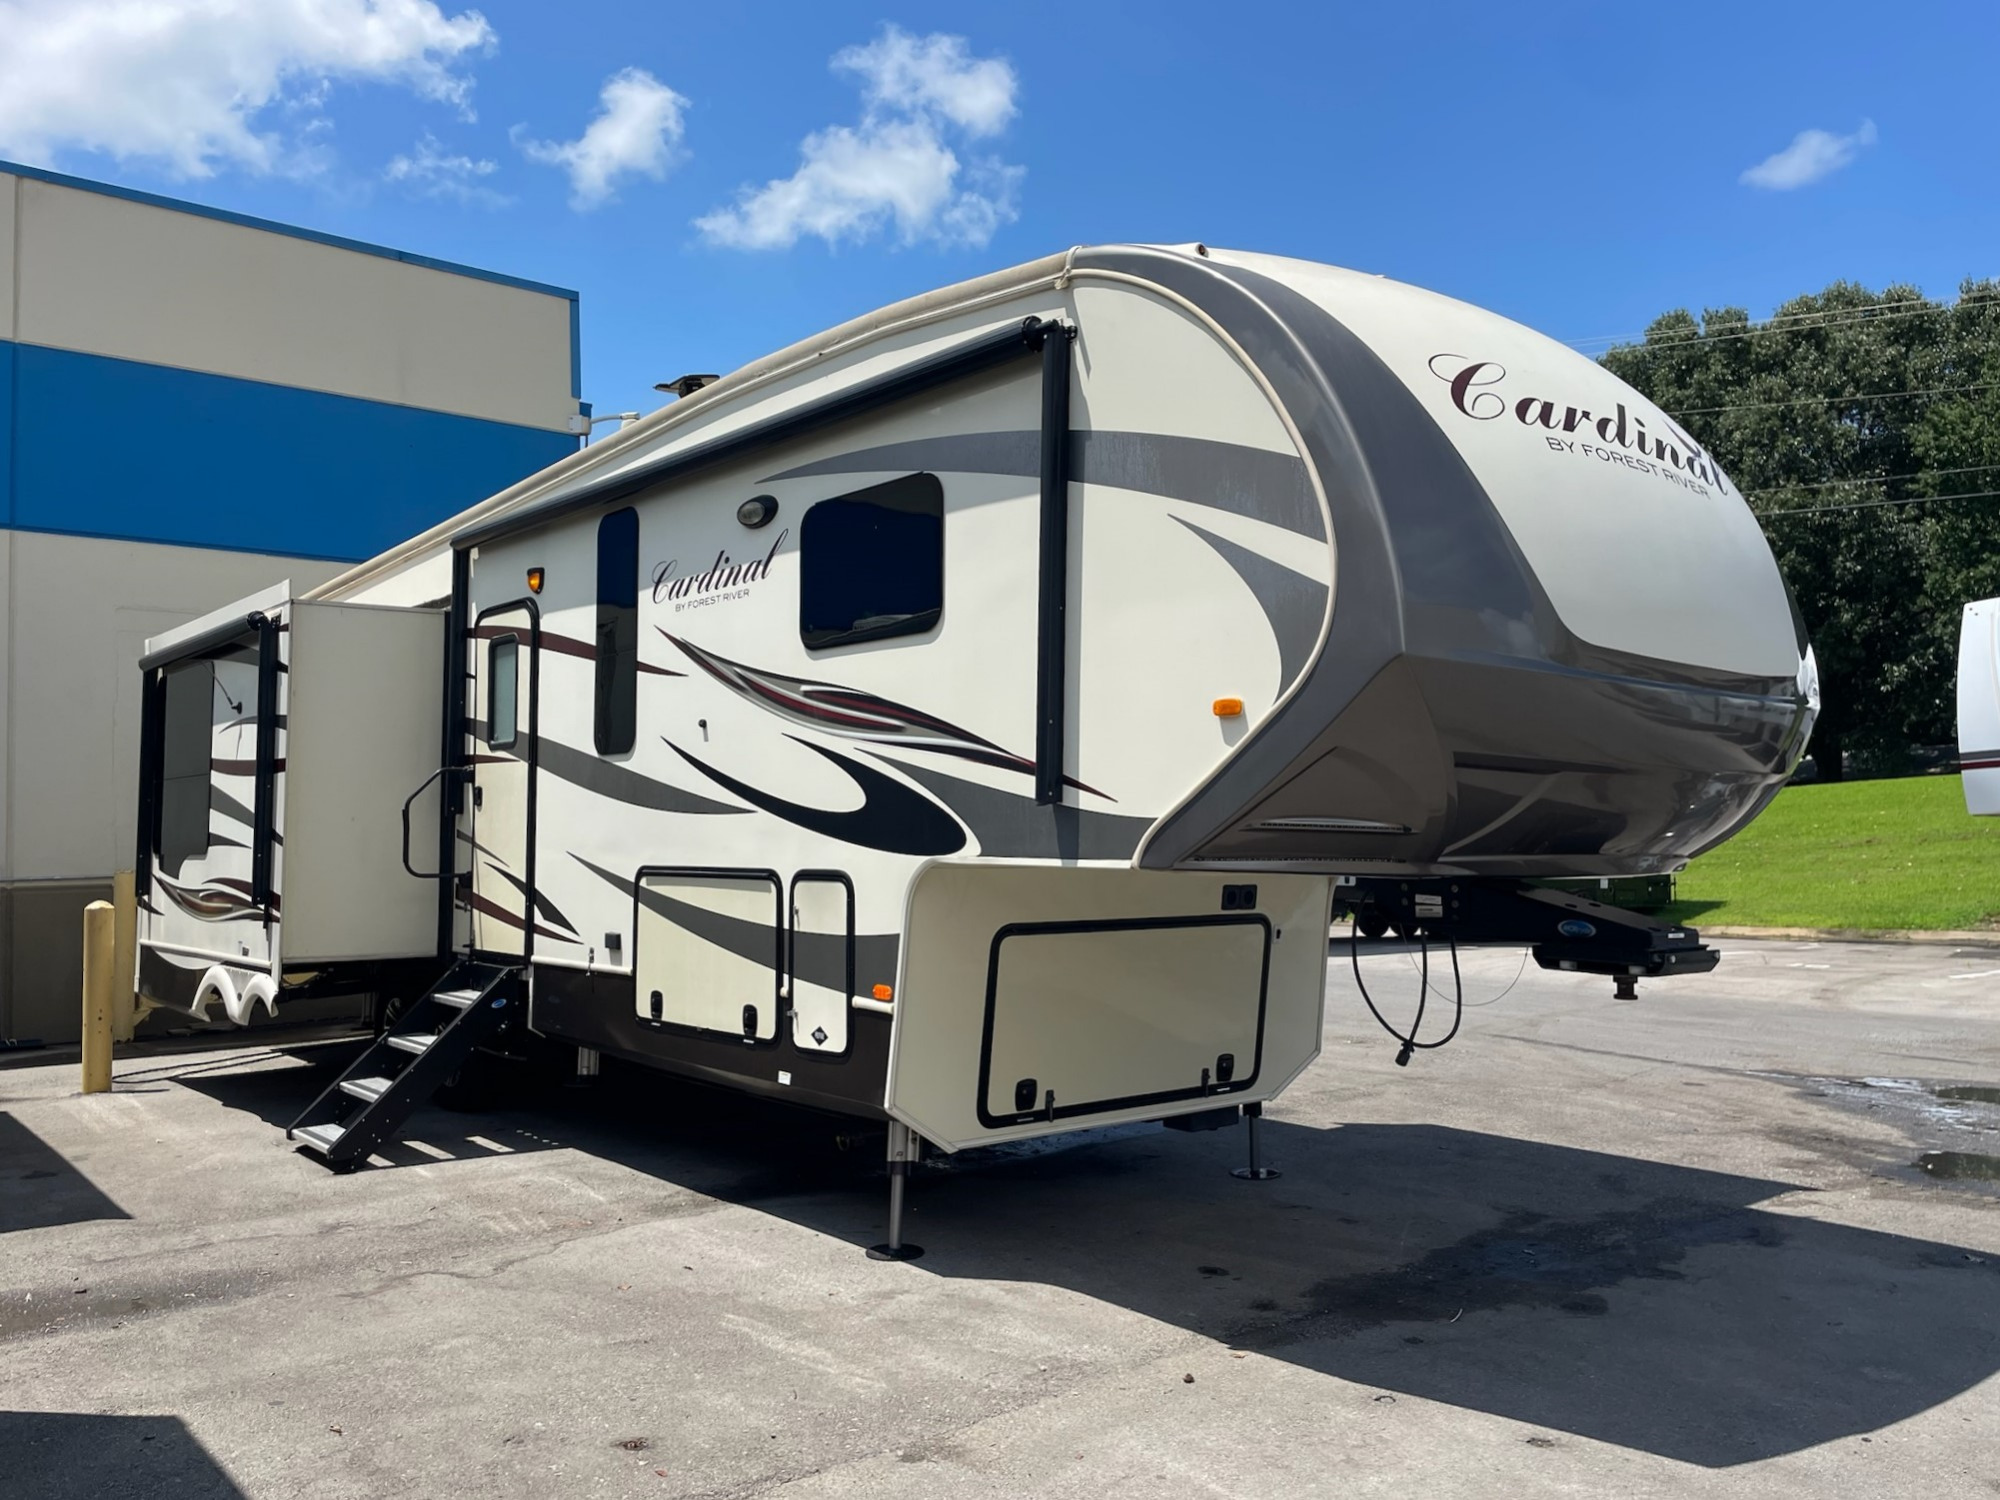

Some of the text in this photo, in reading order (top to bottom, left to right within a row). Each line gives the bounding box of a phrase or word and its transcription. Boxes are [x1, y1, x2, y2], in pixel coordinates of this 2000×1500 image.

[1428, 353, 1728, 496] Cardinal
[1546, 437, 1711, 499] BY FOREST RIVER
[652, 528, 789, 604] Cardinal
[675, 588, 750, 612] BY FOREST RIVER
